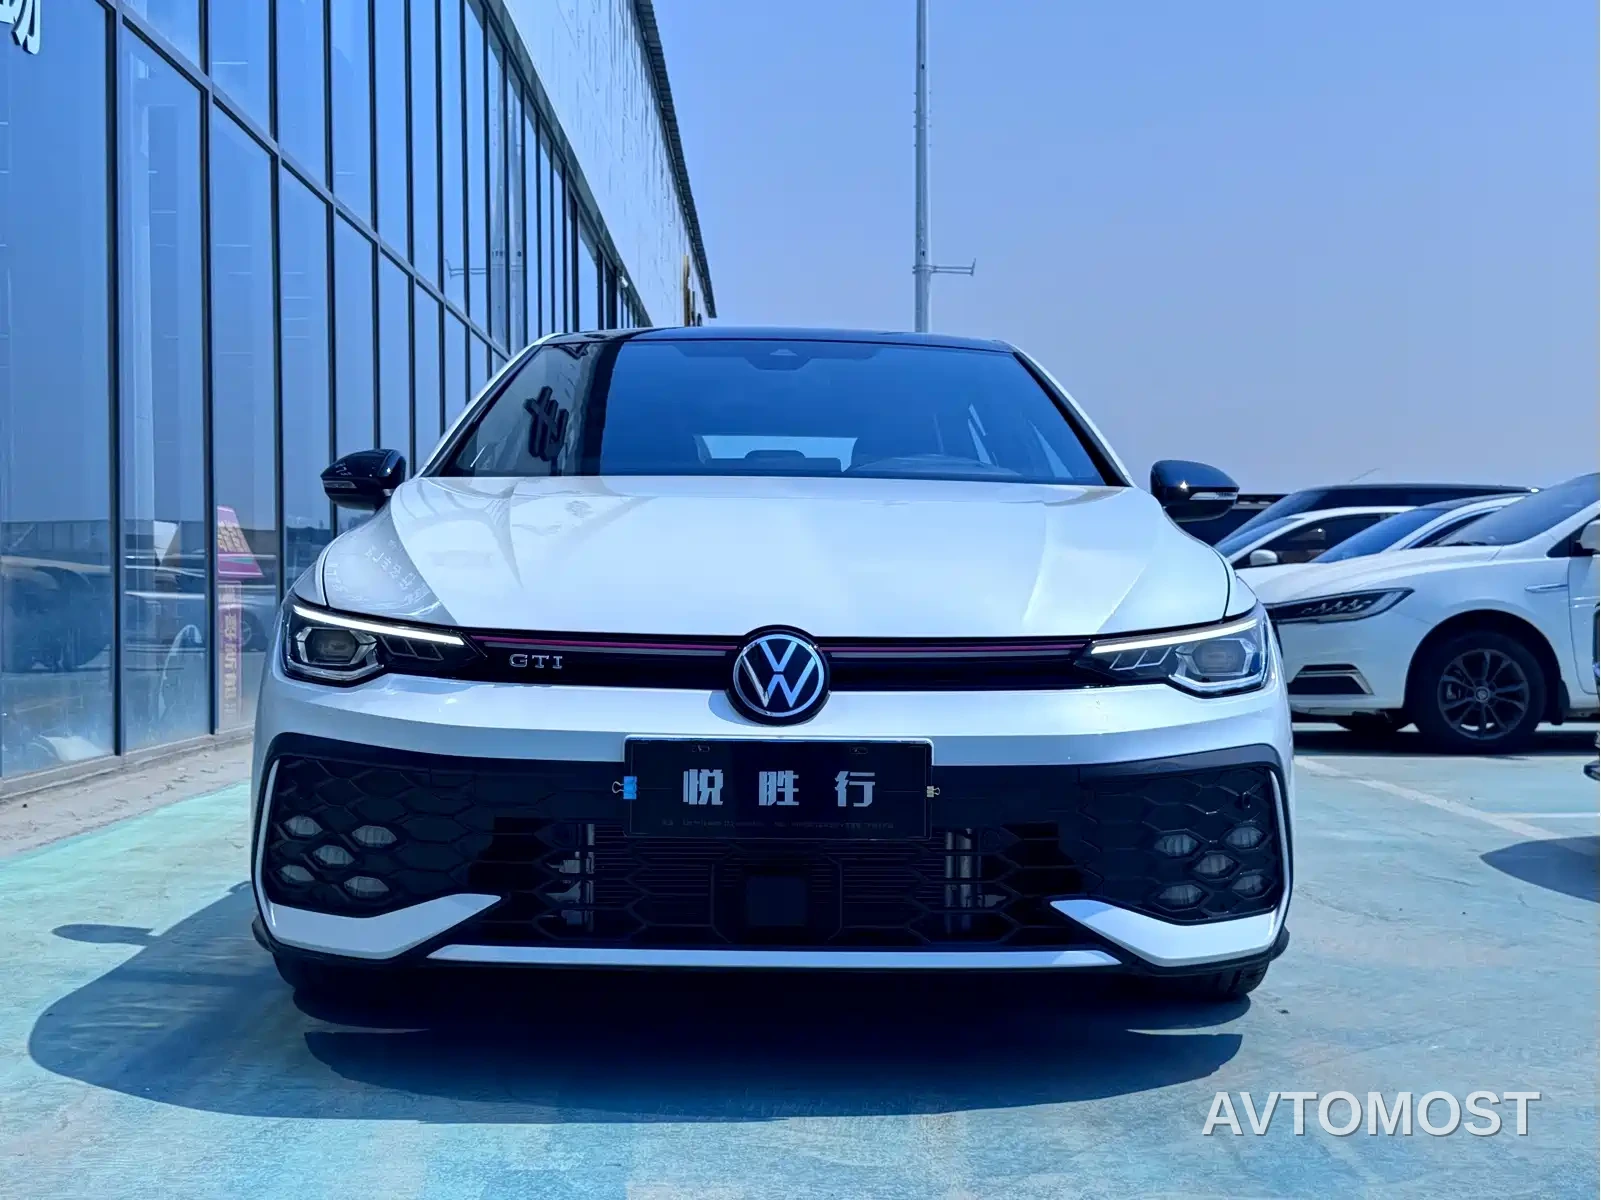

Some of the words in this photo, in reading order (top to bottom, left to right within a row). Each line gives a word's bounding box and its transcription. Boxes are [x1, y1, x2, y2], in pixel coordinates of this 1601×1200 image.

[508, 653, 563, 669] GTI
[737, 637, 819, 712] VW
[682, 768, 876, 807] 悦胜行
